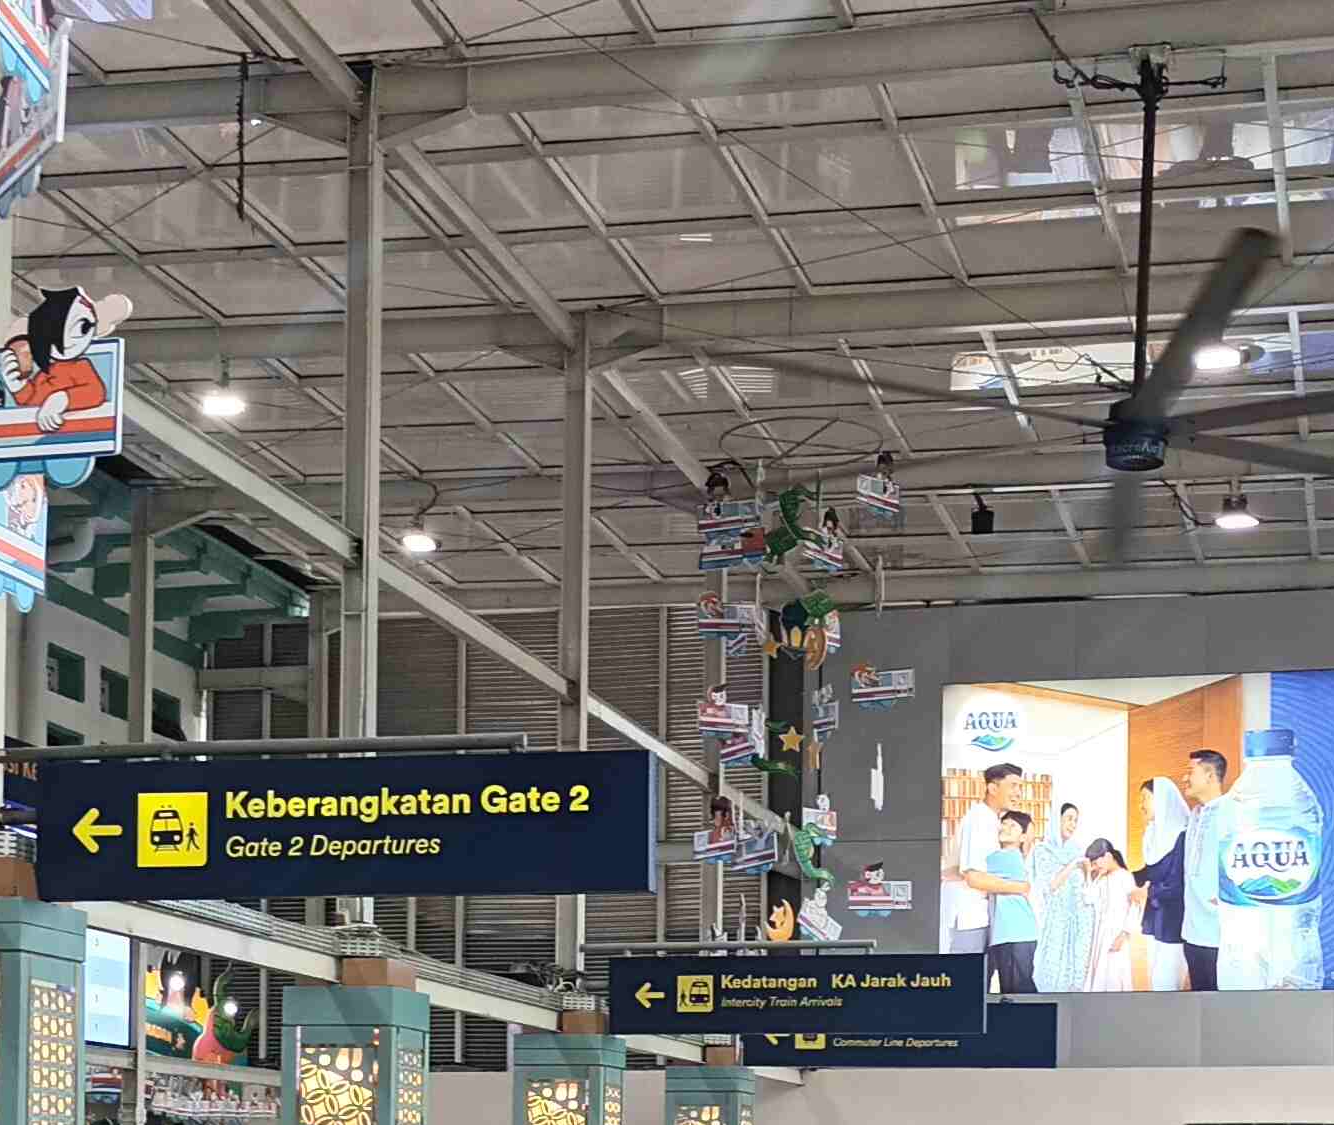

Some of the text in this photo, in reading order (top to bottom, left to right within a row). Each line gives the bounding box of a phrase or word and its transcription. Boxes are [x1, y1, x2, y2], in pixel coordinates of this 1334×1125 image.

[963, 711, 1018, 733] AQUA
[225, 784, 591, 823] Keberangkatan Gate 2
[225, 833, 442, 861] Gate 2 Departures
[1231, 839, 1309, 873] AQUA
[720, 972, 952, 992] Kedatangan KA Jarak Jauh
[720, 995, 844, 1009] Intercity Train Arrivals
